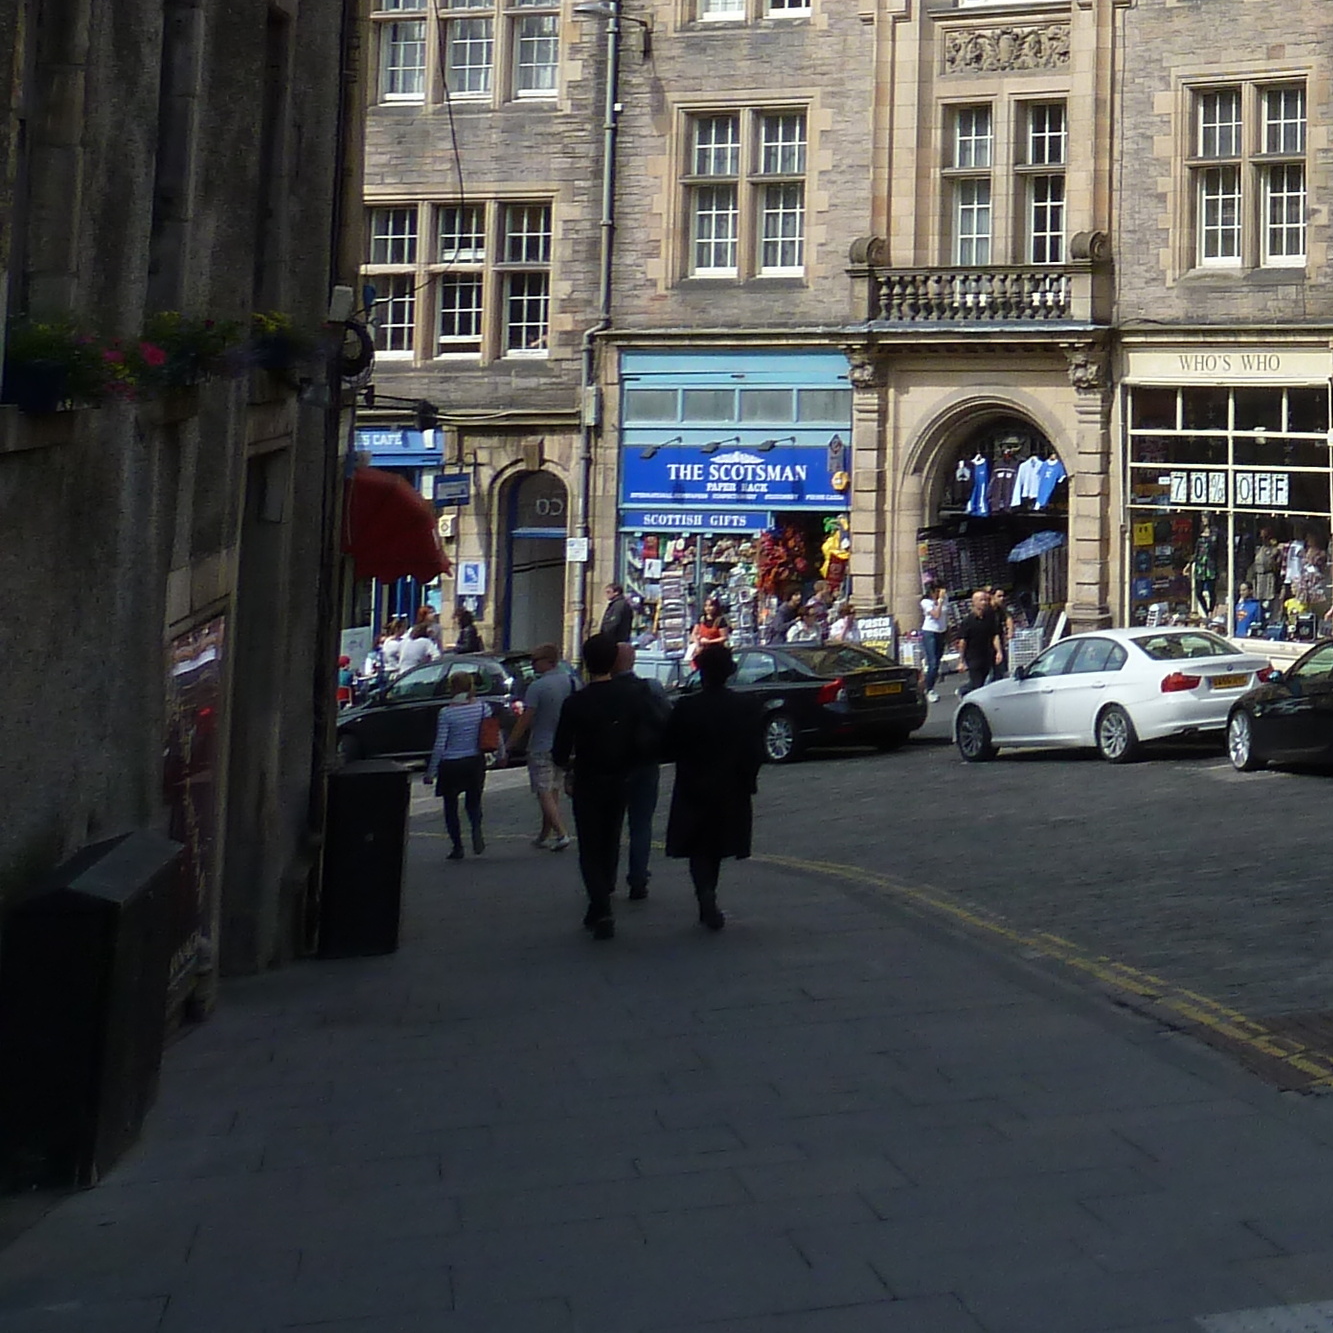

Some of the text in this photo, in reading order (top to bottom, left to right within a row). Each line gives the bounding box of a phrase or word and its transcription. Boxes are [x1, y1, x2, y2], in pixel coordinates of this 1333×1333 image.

[1179, 354, 1280, 371] WHO'S WHO
[666, 464, 807, 481] THE SCOTSMAN
[1172, 476, 1285, 501] 70% OFF
[643, 514, 747, 527] SCOTTISH GIFTS
